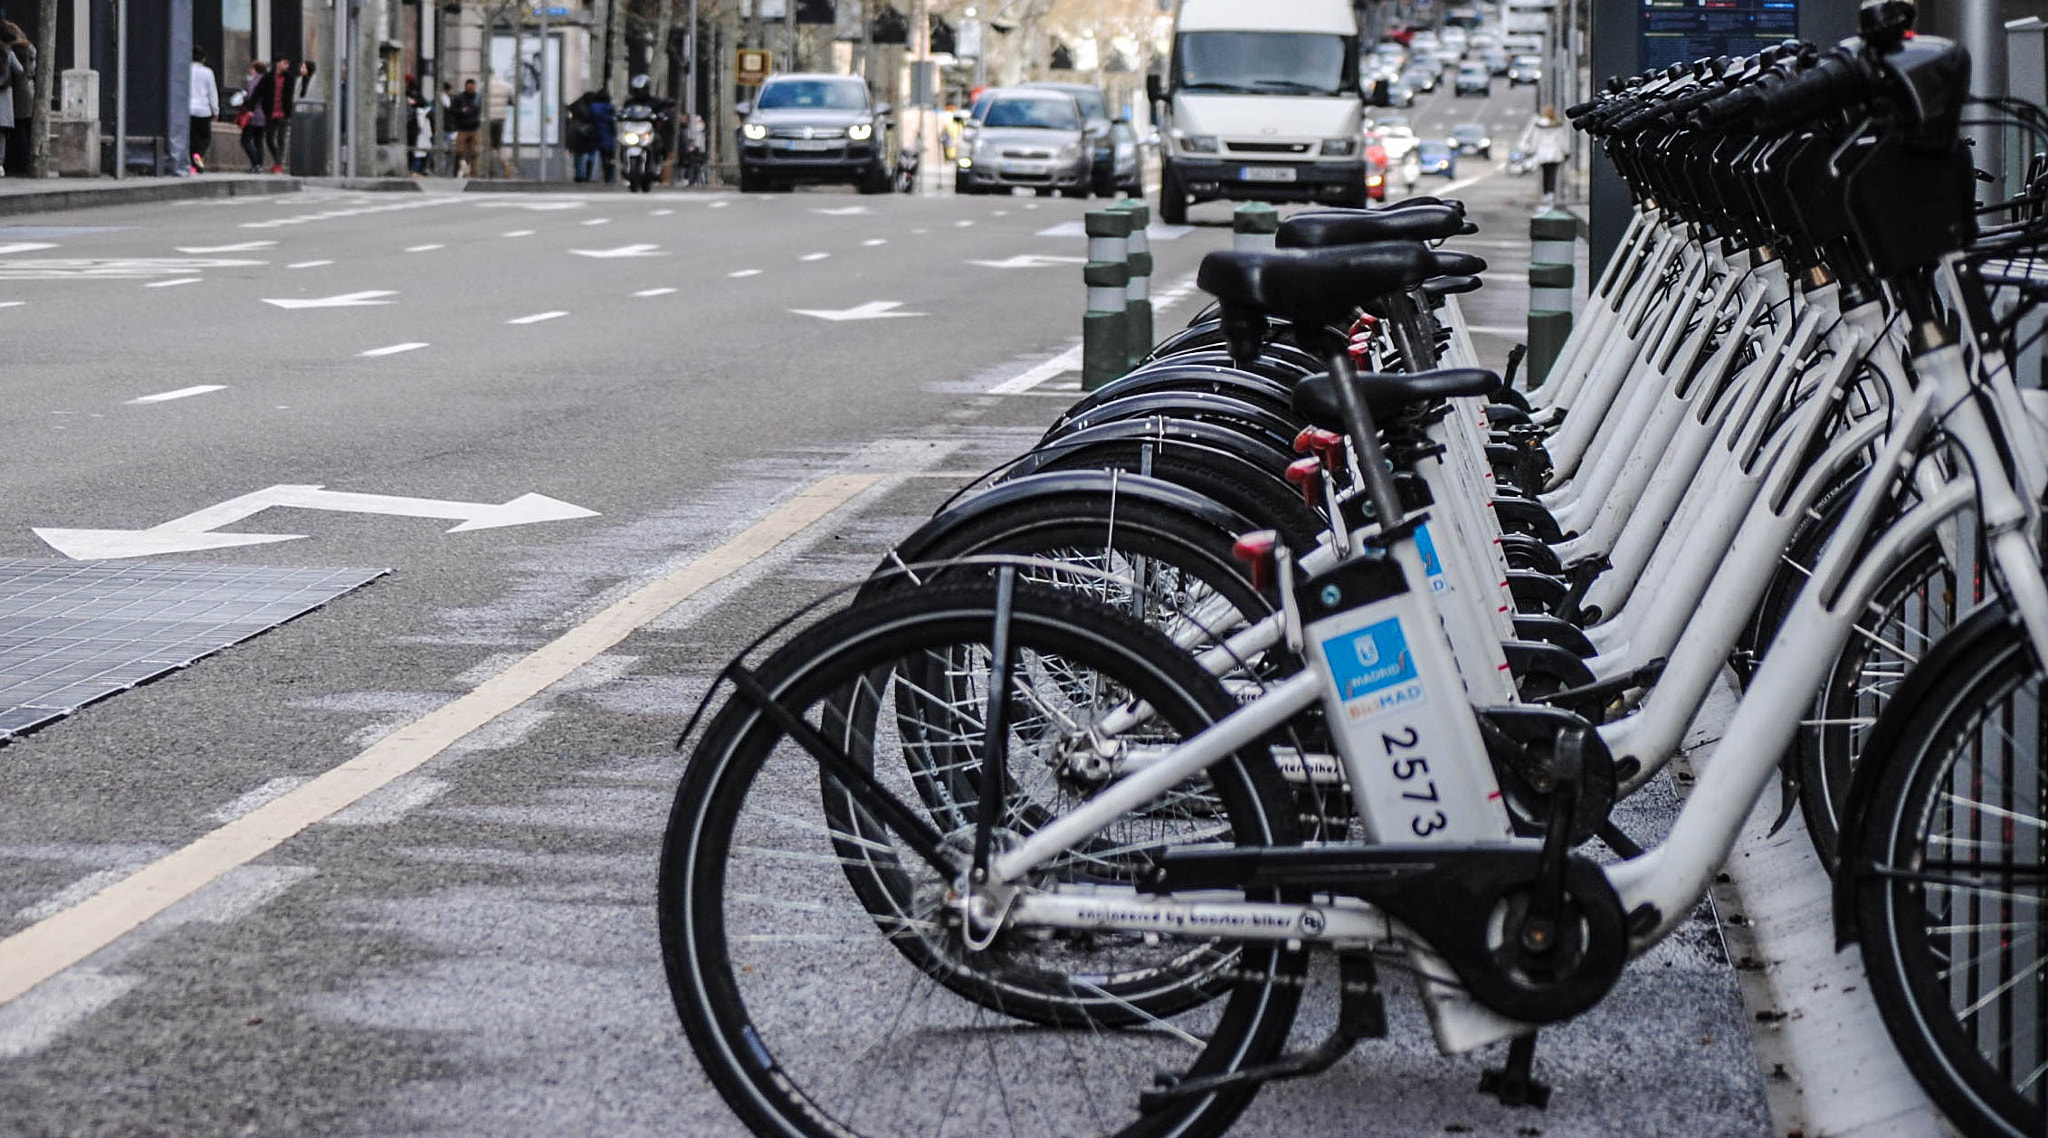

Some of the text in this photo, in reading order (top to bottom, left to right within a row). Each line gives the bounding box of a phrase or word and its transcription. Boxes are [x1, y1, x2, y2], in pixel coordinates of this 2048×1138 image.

[1351, 662, 1401, 688] MADRID
[1381, 726, 1447, 838] 2573
[1166, 911, 1184, 926] by
